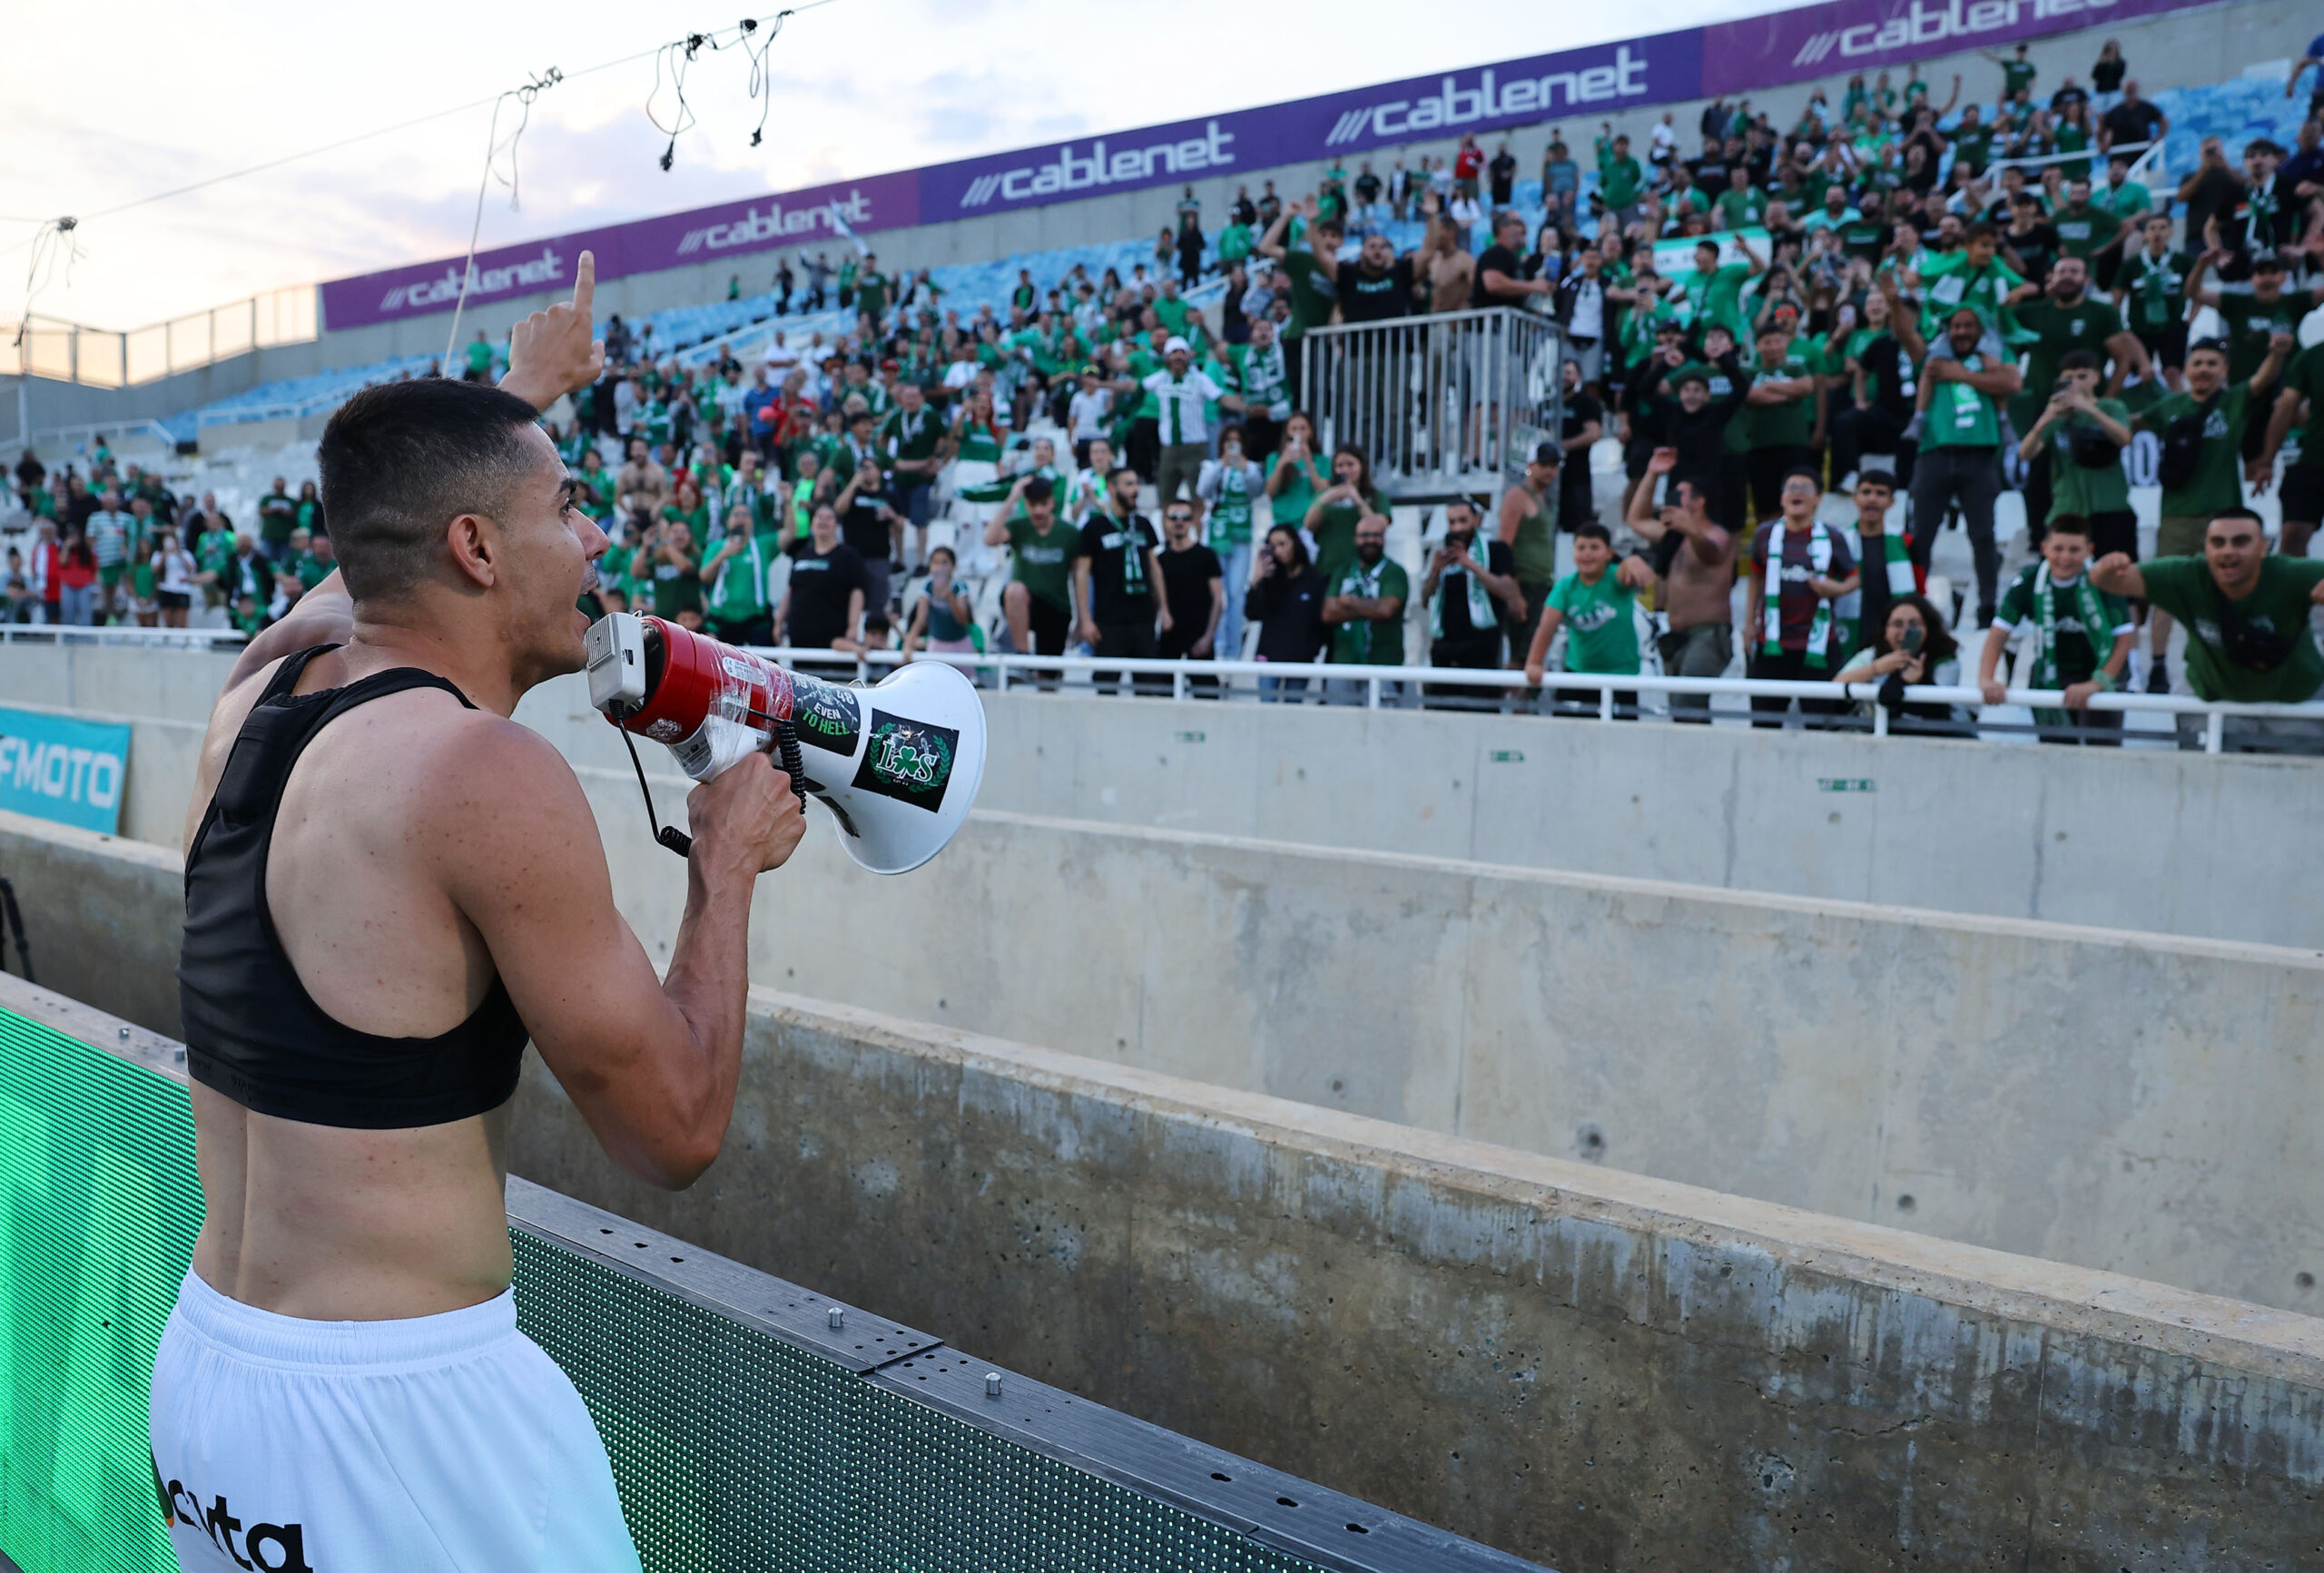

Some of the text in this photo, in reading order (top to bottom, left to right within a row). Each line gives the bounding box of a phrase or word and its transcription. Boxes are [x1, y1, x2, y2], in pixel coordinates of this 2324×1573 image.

[1839, 0, 2120, 56] cablen
[1373, 45, 1648, 136] cablenet
[1001, 120, 1236, 200] cablenet
[408, 247, 565, 307] cablenet
[802, 707, 851, 736] TO HELL
[813, 702, 842, 720] EVEN
[836, 689, 855, 705] 48
